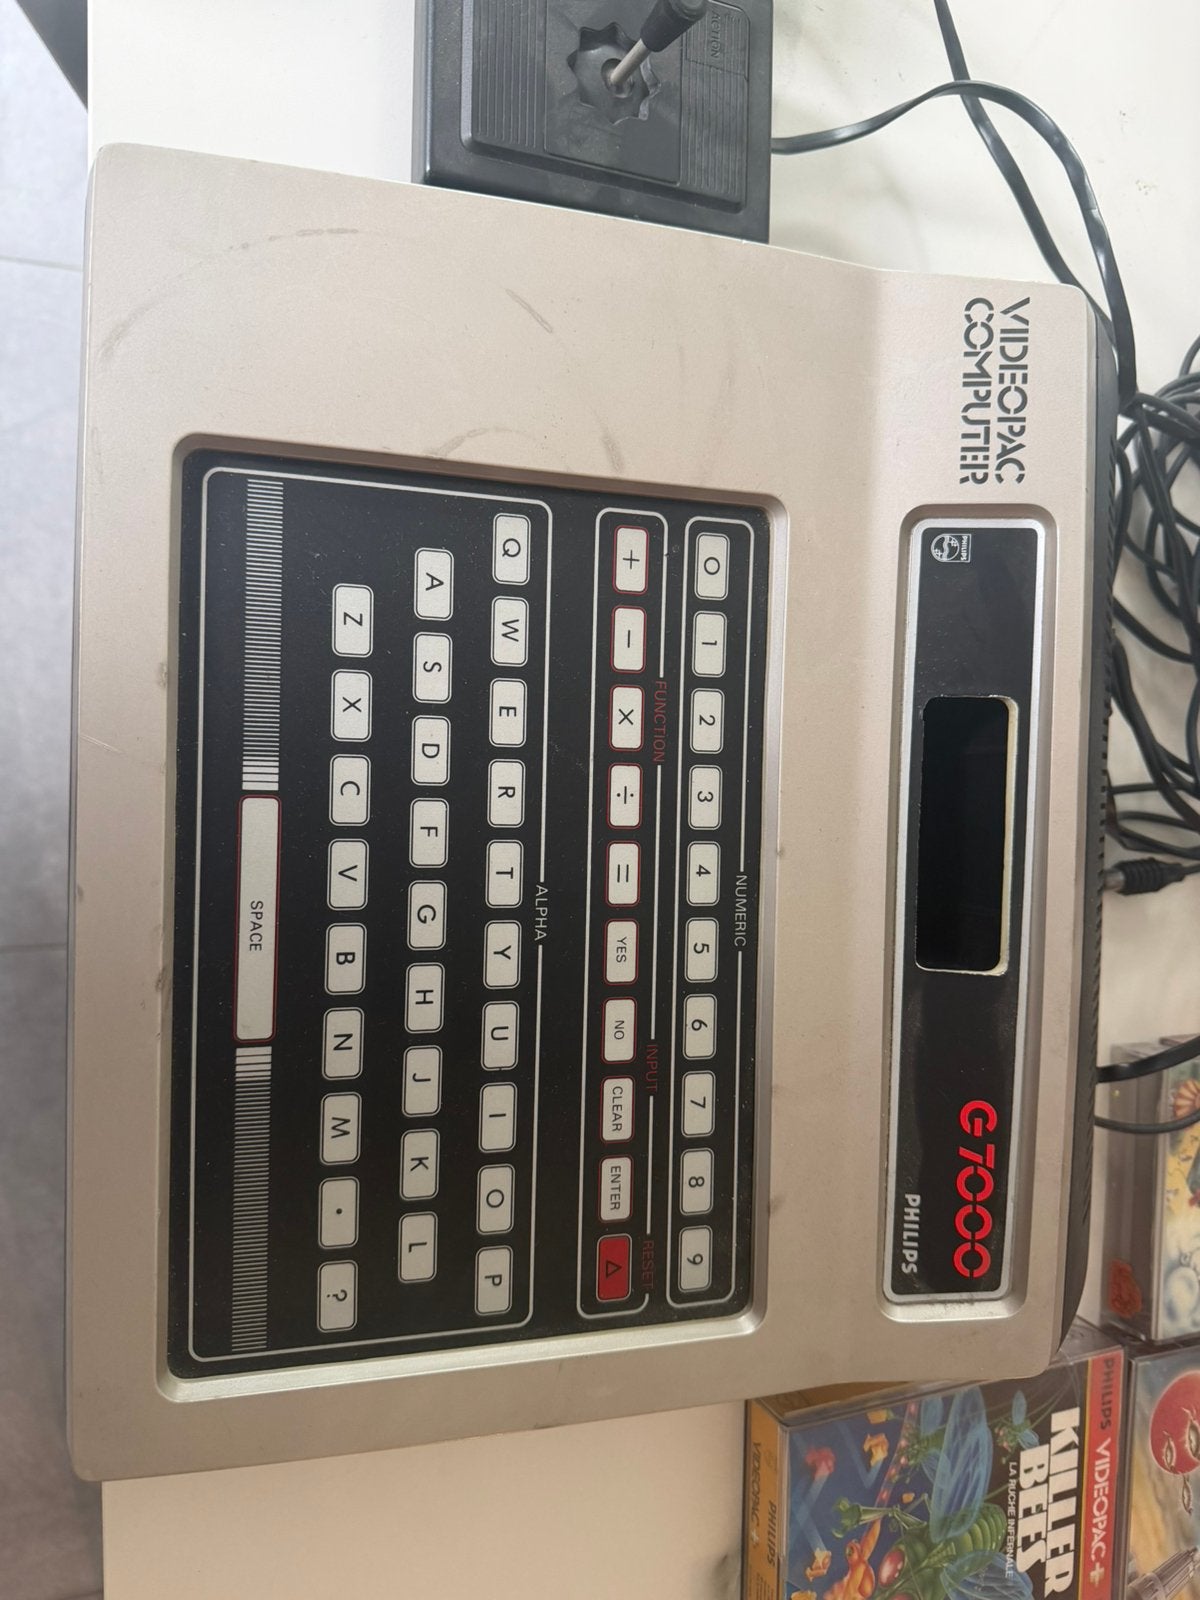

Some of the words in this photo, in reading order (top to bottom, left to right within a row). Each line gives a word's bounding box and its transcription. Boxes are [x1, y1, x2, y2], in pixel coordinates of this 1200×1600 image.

[710, 10, 721, 59] ACTION
[959, 297, 995, 485] COMPUTER
[995, 297, 1031, 485] VIDEOPAC
[501, 537, 522, 558] Q
[960, 535, 968, 562] PHILIPS
[425, 572, 445, 592] A
[343, 611, 363, 627] Z
[501, 618, 520, 643] W
[422, 661, 442, 673] S
[342, 696, 362, 713] X
[498, 705, 517, 717] E
[653, 680, 667, 763] FUNCTION
[699, 714, 716, 726] 2
[421, 742, 440, 759] D
[340, 780, 361, 796] C
[497, 786, 516, 799] R
[697, 790, 714, 803] 3
[419, 826, 439, 838] F
[337, 864, 358, 882] V
[495, 866, 514, 880] T
[695, 864, 712, 878] 4
[416, 904, 437, 925] G
[534, 885, 548, 941] ALPHA
[734, 875, 748, 947] NUMERIC
[249, 900, 264, 952] SPACE
[493, 945, 512, 960] Y
[615, 936, 627, 963] YES
[693, 942, 710, 955] 5
[335, 951, 356, 966] B
[415, 989, 434, 1005] H
[490, 1025, 509, 1041] U
[613, 1020, 625, 1040] NO
[691, 1018, 708, 1032] 6
[332, 1033, 354, 1051] N
[412, 1072, 432, 1083] J
[645, 1044, 658, 1094] INPUT
[611, 1086, 624, 1132] CLEAR
[690, 1096, 707, 1109] 7
[330, 1116, 351, 1139] M
[410, 1156, 429, 1172] K
[610, 1165, 622, 1211] ENTER
[688, 1176, 705, 1189] 8
[901, 1193, 922, 1275] PHILIPS
[408, 1241, 428, 1253] L
[642, 1240, 654, 1290] RESET
[686, 1253, 704, 1266] 9
[484, 1274, 503, 1287] P
[326, 1289, 348, 1302] ?
[1100, 1358, 1115, 1430] PHILIPS
[1008, 1462, 1017, 1476] LA
[1006, 1479, 1017, 1516] RUCHE
[1044, 1407, 1080, 1599] KILLER
[1016, 1444, 1050, 1573] BEES
[767, 1500, 777, 1567] PHILIPS
[1004, 1518, 1015, 1578] INFERNALE
